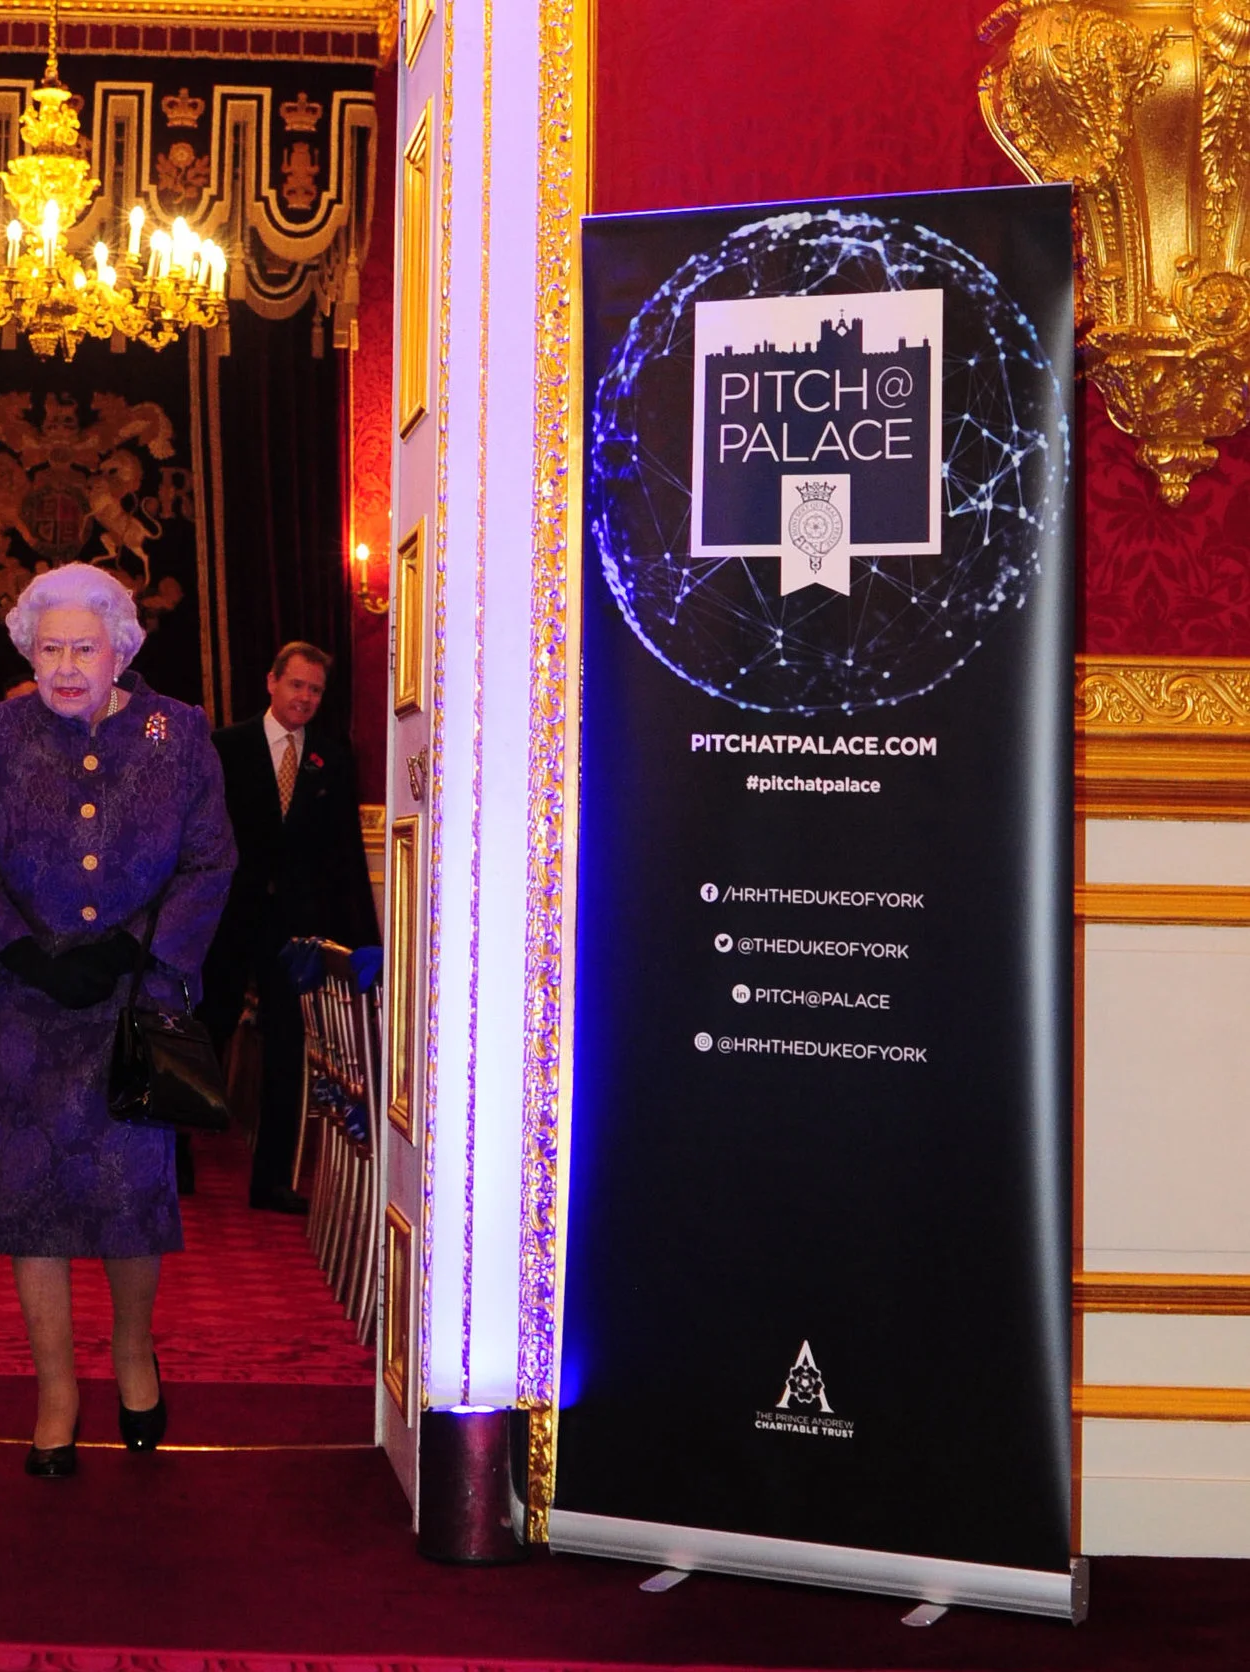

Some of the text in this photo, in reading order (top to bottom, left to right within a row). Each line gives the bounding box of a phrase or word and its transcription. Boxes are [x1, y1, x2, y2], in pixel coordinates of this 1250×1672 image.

[719, 417, 913, 464] PALACE
[691, 733, 937, 756] PITCHATPALACE.COM
[746, 774, 881, 794] #pitchatpalace
[722, 885, 924, 908] /HRHTHEDUKEOFYORK
[737, 937, 909, 959] @THEDUKEOFYORK
[755, 988, 890, 1009] PITCH@PALACE
[717, 1036, 927, 1063] @HRHTHEDUKEOFYORK
[755, 1411, 854, 1429] THE PRINCE ANDREW
[755, 1420, 854, 1439] CHARITABLE TRUST
